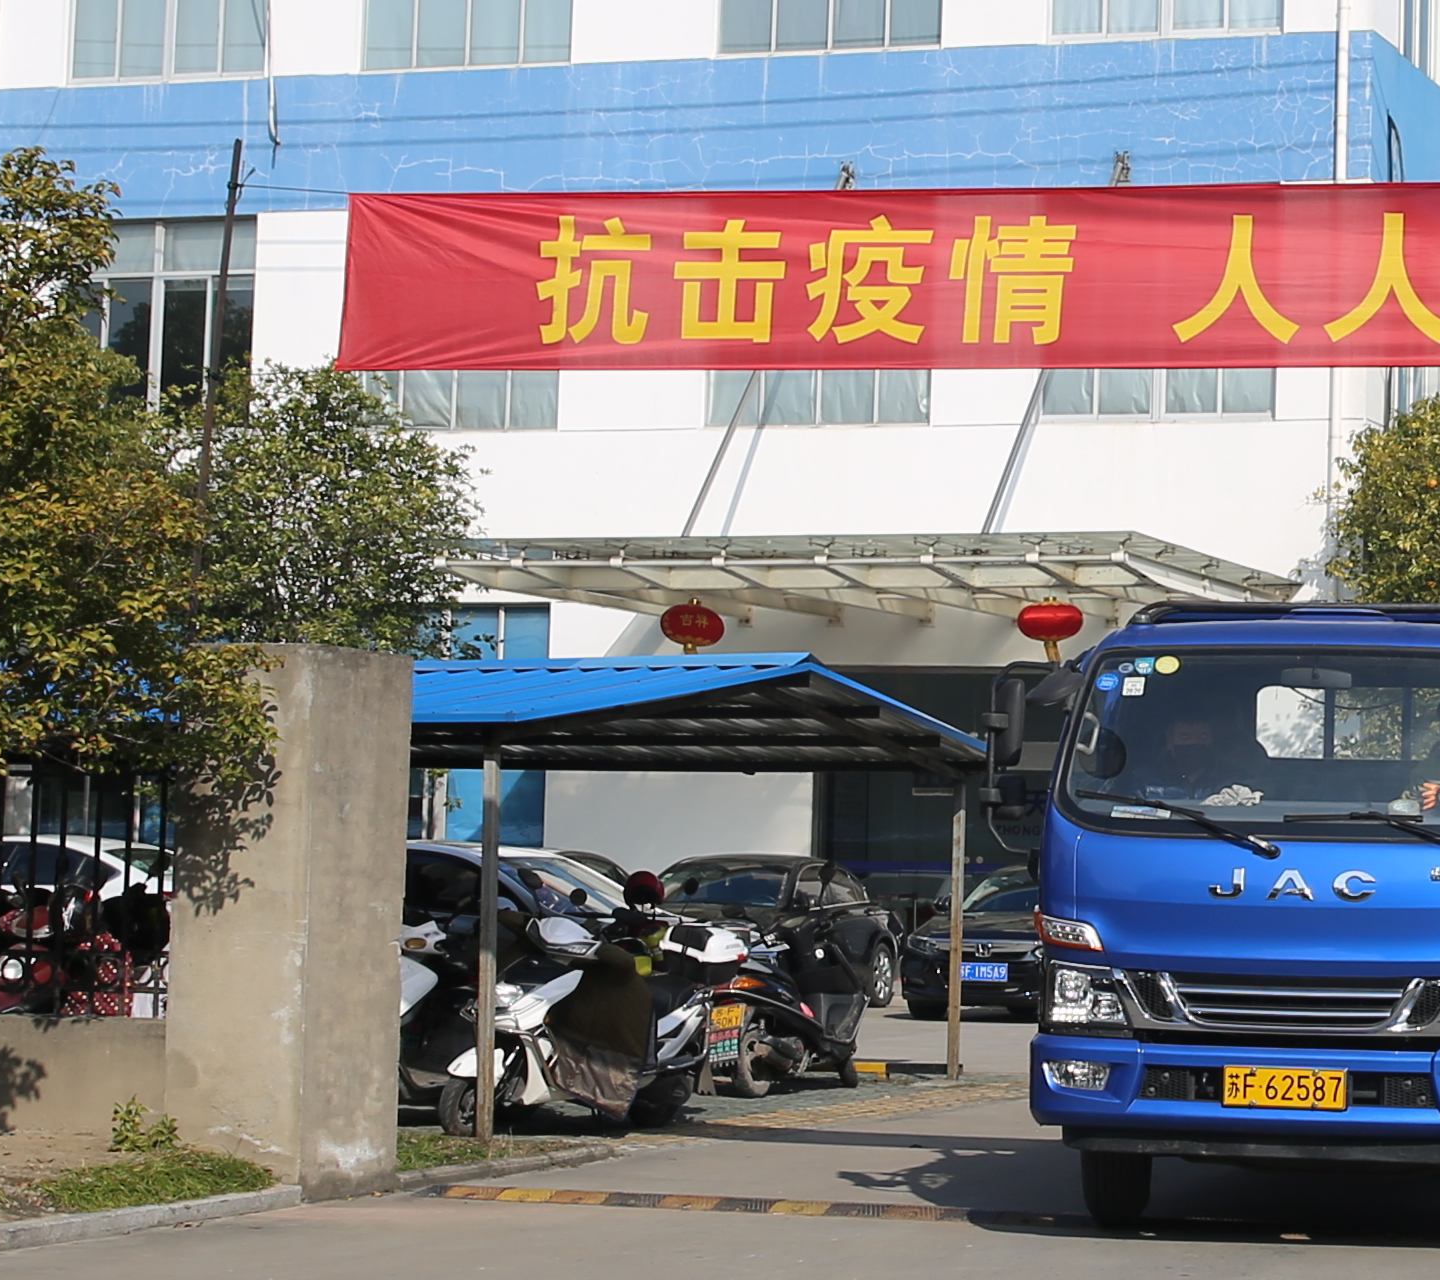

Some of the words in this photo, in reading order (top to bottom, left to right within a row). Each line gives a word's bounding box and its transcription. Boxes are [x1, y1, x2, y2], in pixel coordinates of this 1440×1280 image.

[537, 215, 1076, 346] 抗击疫情
[1208, 867, 1377, 903] JAC
